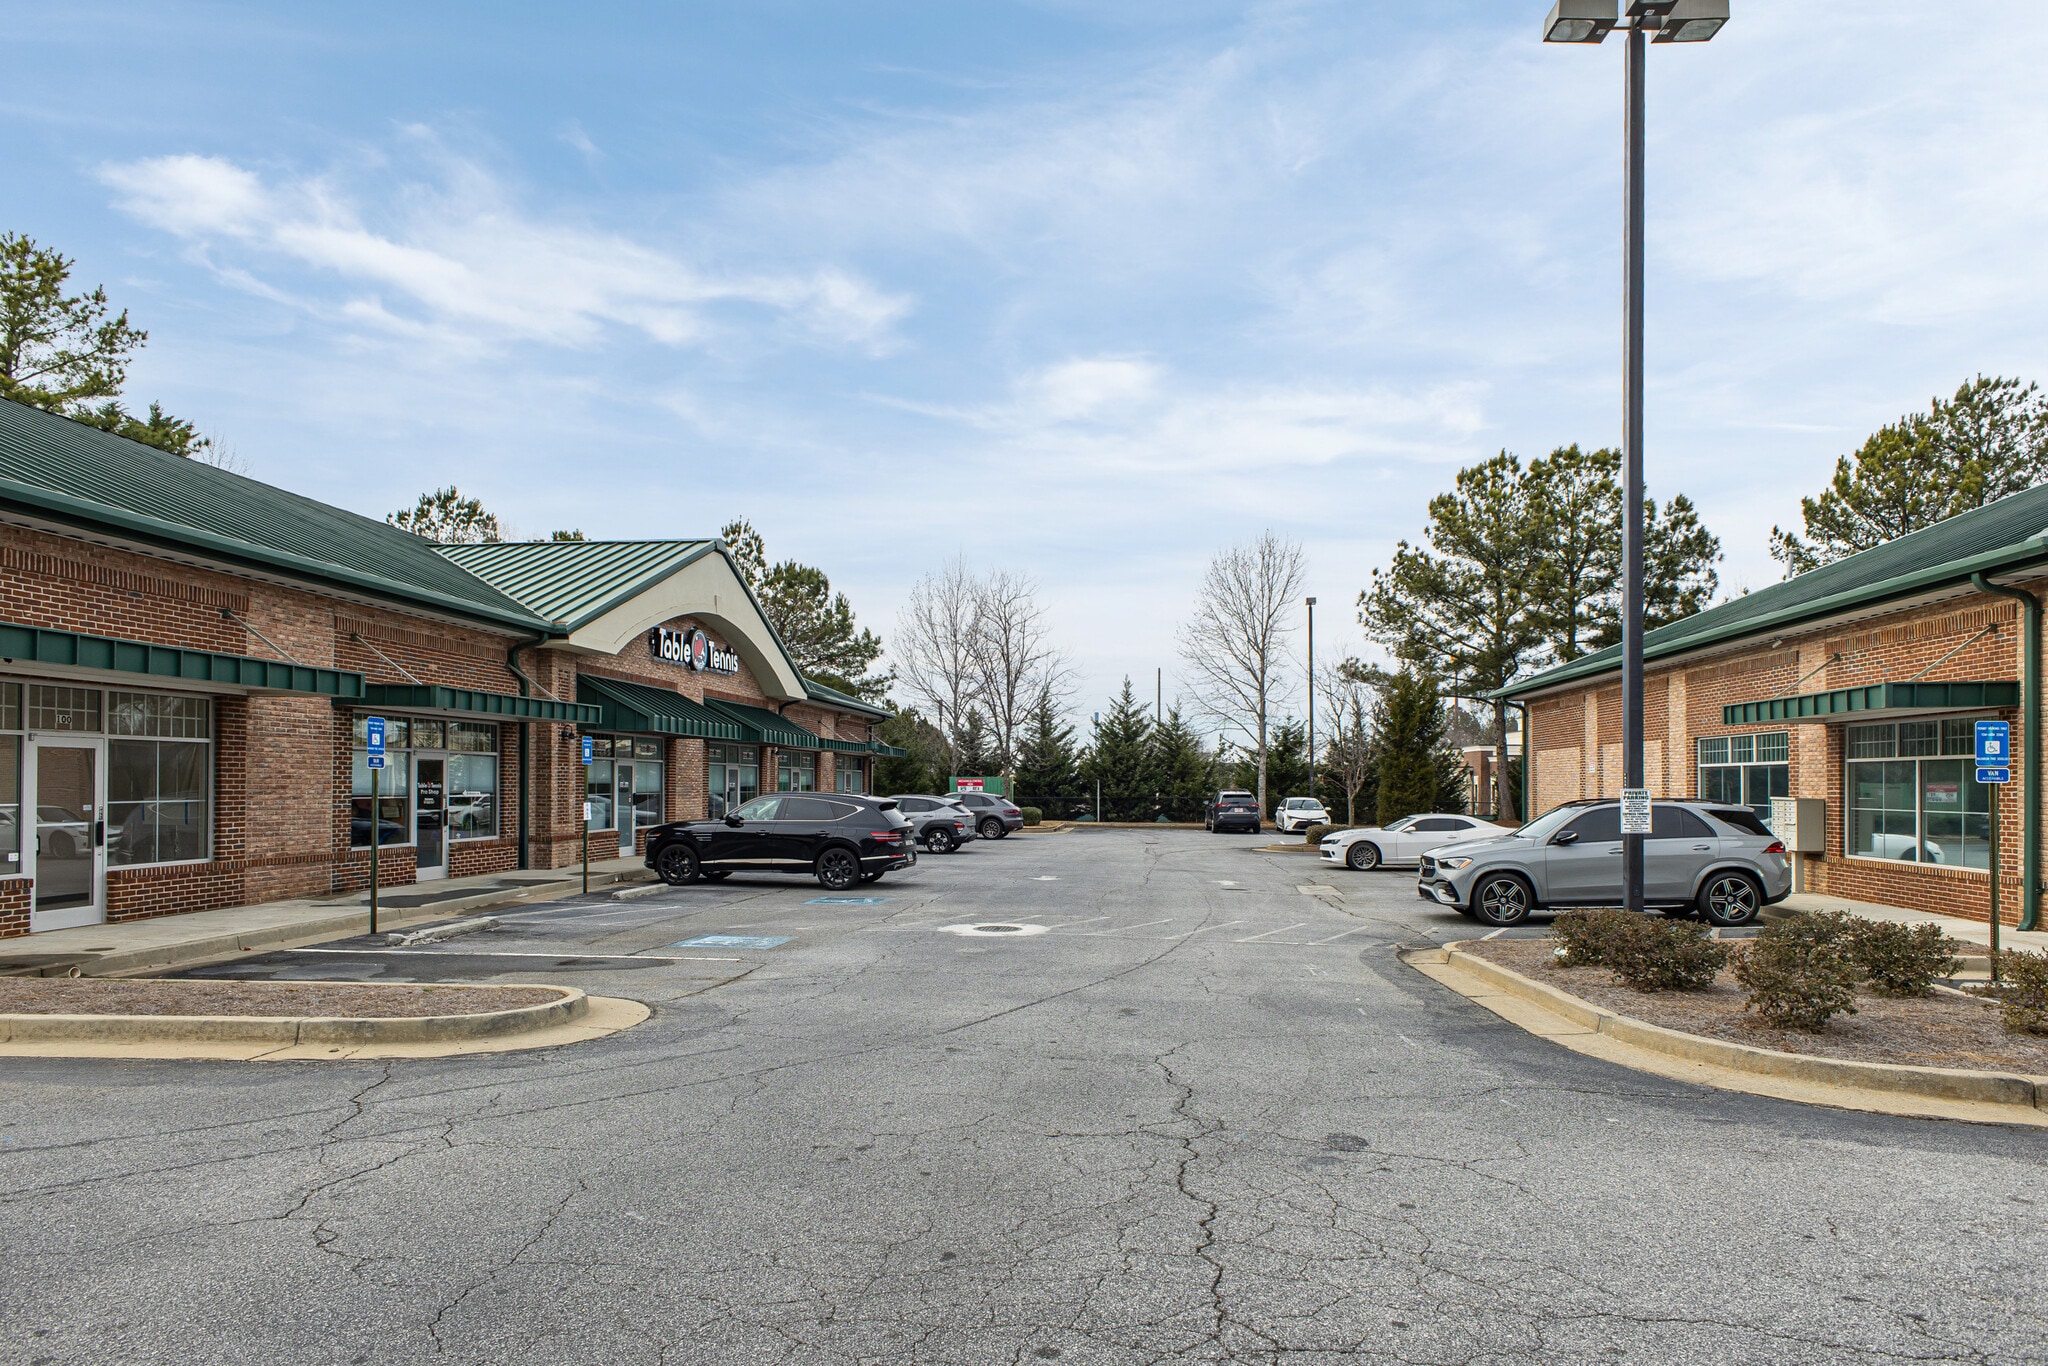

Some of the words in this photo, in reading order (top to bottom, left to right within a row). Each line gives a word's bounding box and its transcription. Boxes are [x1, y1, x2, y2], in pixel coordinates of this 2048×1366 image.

[659, 627, 691, 663] Table
[708, 640, 739, 672] Tennis
[57, 715, 72, 724] 100
